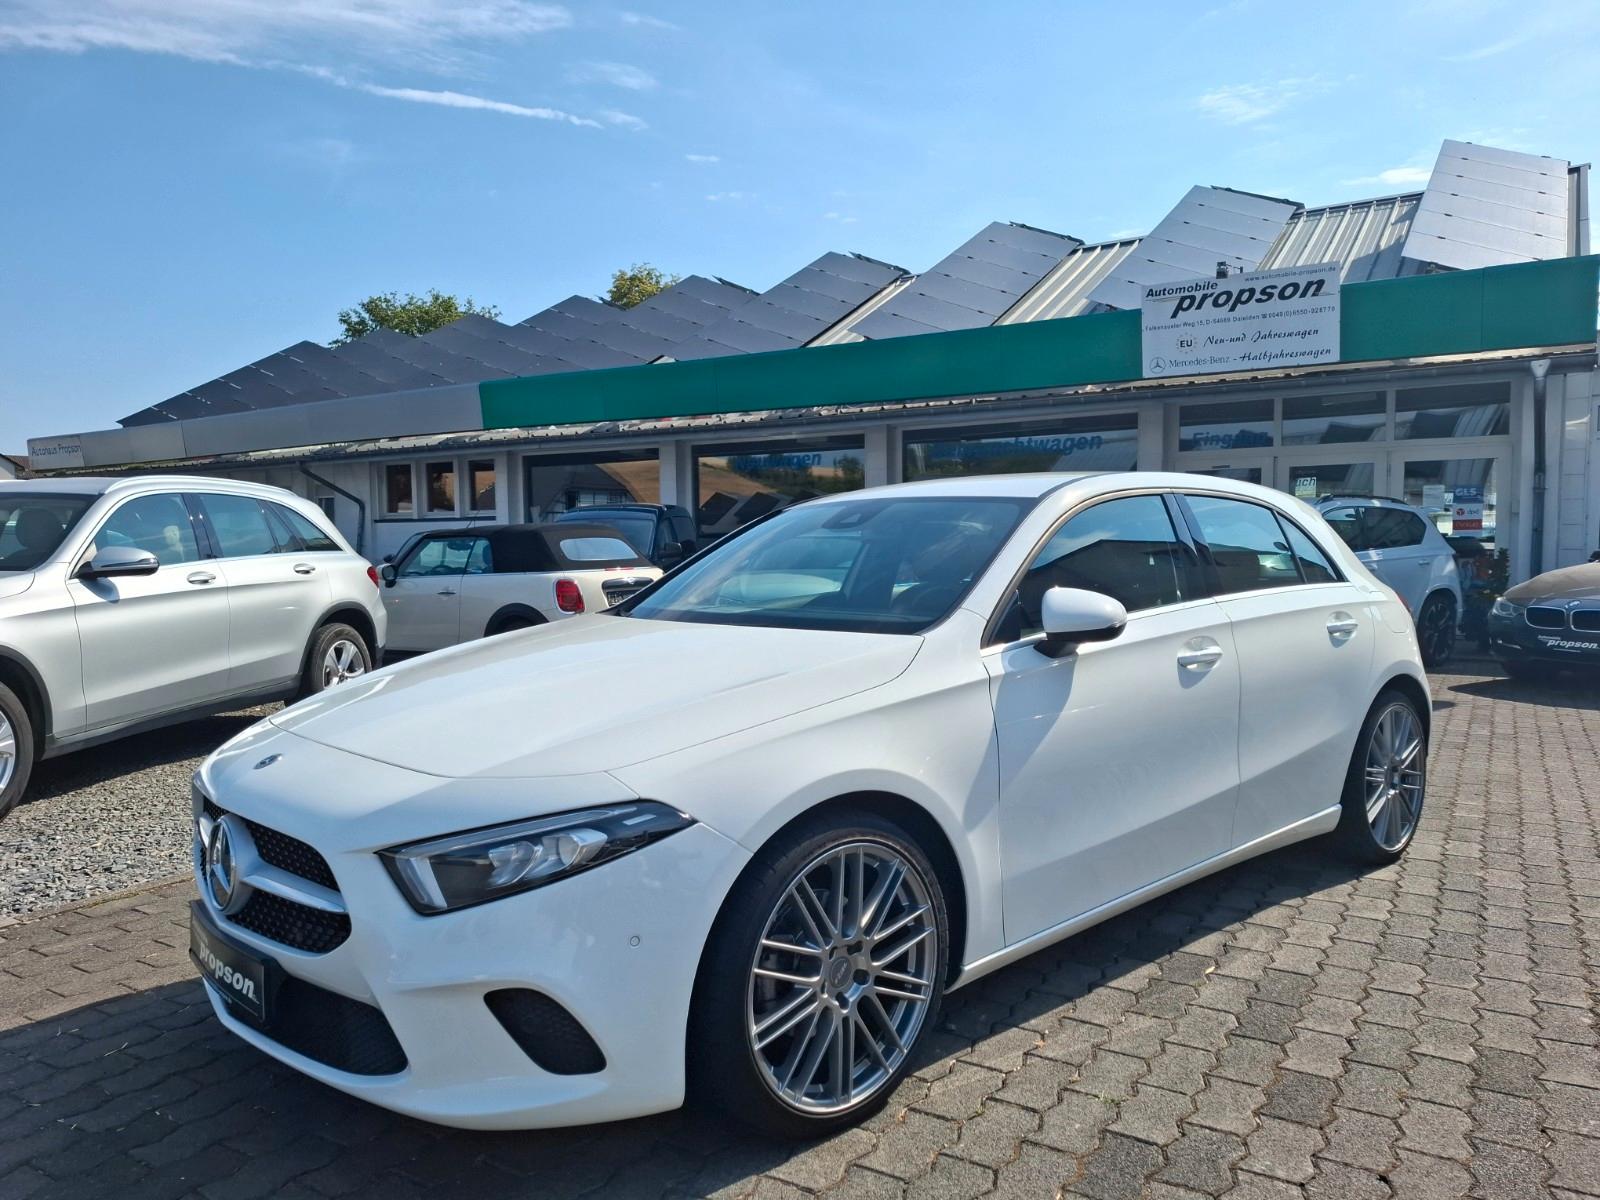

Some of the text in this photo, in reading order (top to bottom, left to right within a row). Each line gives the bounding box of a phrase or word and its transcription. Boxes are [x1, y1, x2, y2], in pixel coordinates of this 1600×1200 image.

[1244, 267, 1336, 281] www.automobile-propson.de
[1145, 282, 1218, 298] Automobile
[1170, 278, 1326, 319] propson
[1250, 328, 1319, 343] Jahreswagen
[1179, 339, 1193, 348] EU
[1169, 355, 1230, 368] Mercedes-Benz
[31, 443, 81, 457] Autohaus Propson
[1455, 488, 1477, 496] GLS
[1546, 639, 1598, 649] propson
[200, 941, 255, 998] propson
